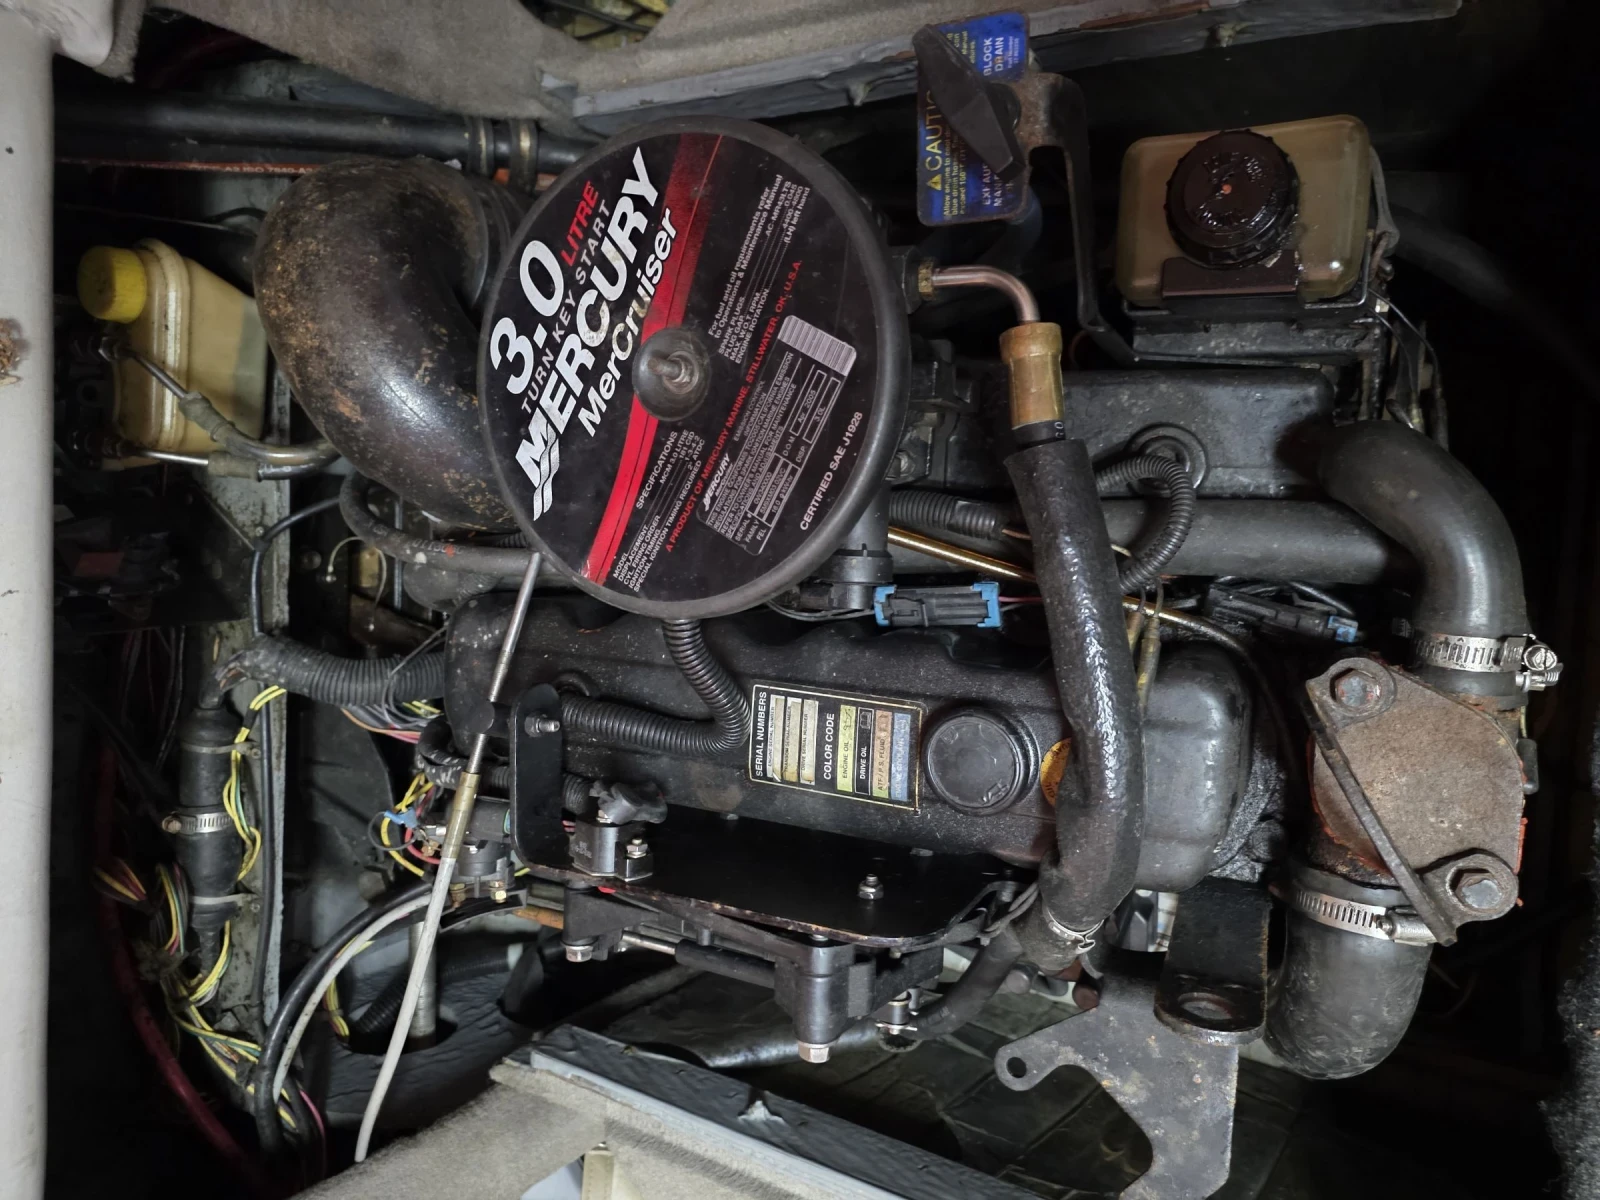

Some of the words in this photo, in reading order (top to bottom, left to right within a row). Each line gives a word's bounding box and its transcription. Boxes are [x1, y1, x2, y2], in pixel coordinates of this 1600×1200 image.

[984, 38, 992, 76] BLOCK
[995, 37, 1004, 71] DRAIN
[926, 90, 942, 171] CAUTI
[490, 240, 564, 395] 3.0
[562, 181, 599, 266] LITRE
[516, 147, 659, 488] MERCURY
[522, 348, 555, 413] TURN
[553, 294, 576, 343] KEY
[575, 200, 610, 285] START
[578, 208, 678, 437] MerCruiser
[708, 319, 719, 336] For
[715, 301, 726, 319] fuel
[721, 283, 733, 302] and
[729, 271, 737, 283] oil
[734, 210, 761, 271] requirements
[758, 186, 771, 210] refer
[714, 328, 722, 339] to
[718, 279, 742, 328] Operations
[737, 270, 745, 279] &
[741, 211, 768, 270] Maintenance
[764, 173, 783, 210] Manual
[718, 326, 734, 355] SPARK
[730, 296, 746, 326] PLUGS
[765, 180, 792, 236] AC-MR43LTS
[724, 334, 738, 358] PLUG
[734, 314, 745, 334] GAP
[784, 183, 798, 207] 0.045
[729, 339, 742, 361] MAX.
[749, 291, 761, 313] RPM
[735, 331, 753, 364] ENGINE
[749, 288, 770, 332] ROTATION
[783, 224, 796, 244] (LH)
[791, 209, 801, 225] left
[797, 186, 811, 210] hand
[665, 543, 673, 552] A
[670, 495, 697, 544] PRODUCT
[693, 479, 705, 495] OF
[701, 428, 729, 479] MERCURY
[726, 383, 750, 428] MARINE,
[745, 313, 780, 383] STILLWATER,
[784, 258, 802, 292] U.S.A.
[703, 452, 730, 508] MERCURY
[734, 410, 751, 441] EMISSION
[748, 379, 765, 410] CONTROL
[709, 511, 718, 526] THIS
[716, 488, 730, 512] ENGINE
[728, 451, 748, 488] CONFORMS
[757, 385, 779, 425] CALIFORNIA
[776, 352, 794, 385] EMISSION
[714, 488, 737, 530] REGULATIONS
[734, 475, 744, 489] FOR
[741, 455, 753, 476] SPARK
[751, 428, 766, 455] IGNITION
[763, 404, 777, 429] MARINE
[774, 376, 790, 404] ENGINES
[721, 512, 735, 534] REFER
[732, 503, 739, 512] TO
[752, 445, 768, 473] MANUAL
[764, 430, 774, 445] FOR
[771, 383, 797, 430] MAINTENANCE
[743, 392, 767, 436] INFORMATION
[804, 389, 816, 408] 2005
[613, 551, 628, 578] MODEL
[660, 463, 672, 484] MCM
[670, 452, 678, 463] 3.0
[675, 429, 689, 452] LITRE
[619, 524, 649, 582] DISPLACEMENT
[679, 446, 688, 459] 181
[685, 431, 695, 445] CID
[623, 567, 634, 585] CYL.
[632, 542, 647, 568] FIRING
[644, 515, 660, 542] ORDER
[685, 435, 700, 461] 1-3-4-2
[629, 555, 647, 589] IGNITION
[645, 528, 661, 556] TIMING
[692, 438, 705, 460] ATDC
[634, 561, 651, 592] SPECIAL
[649, 527, 668, 561] IGNITION
[666, 500, 682, 527] TIMING
[679, 459, 702, 500] REQUIRED
[636, 431, 678, 510] SPECIFICATIONS
[726, 486, 754, 538] SPECIFICATIONS
[751, 472, 761, 487] AND
[736, 518, 750, 541] SERIAL
[745, 519, 760, 543] FAMILY
[756, 527, 767, 541] FEL
[799, 470, 834, 531] CERTIFIED
[829, 445, 847, 471] SAE
[841, 410, 863, 446] J1928
[758, 692, 767, 740] NUMBERS
[825, 745, 833, 780] COLOR
[826, 713, 835, 742] CODE
